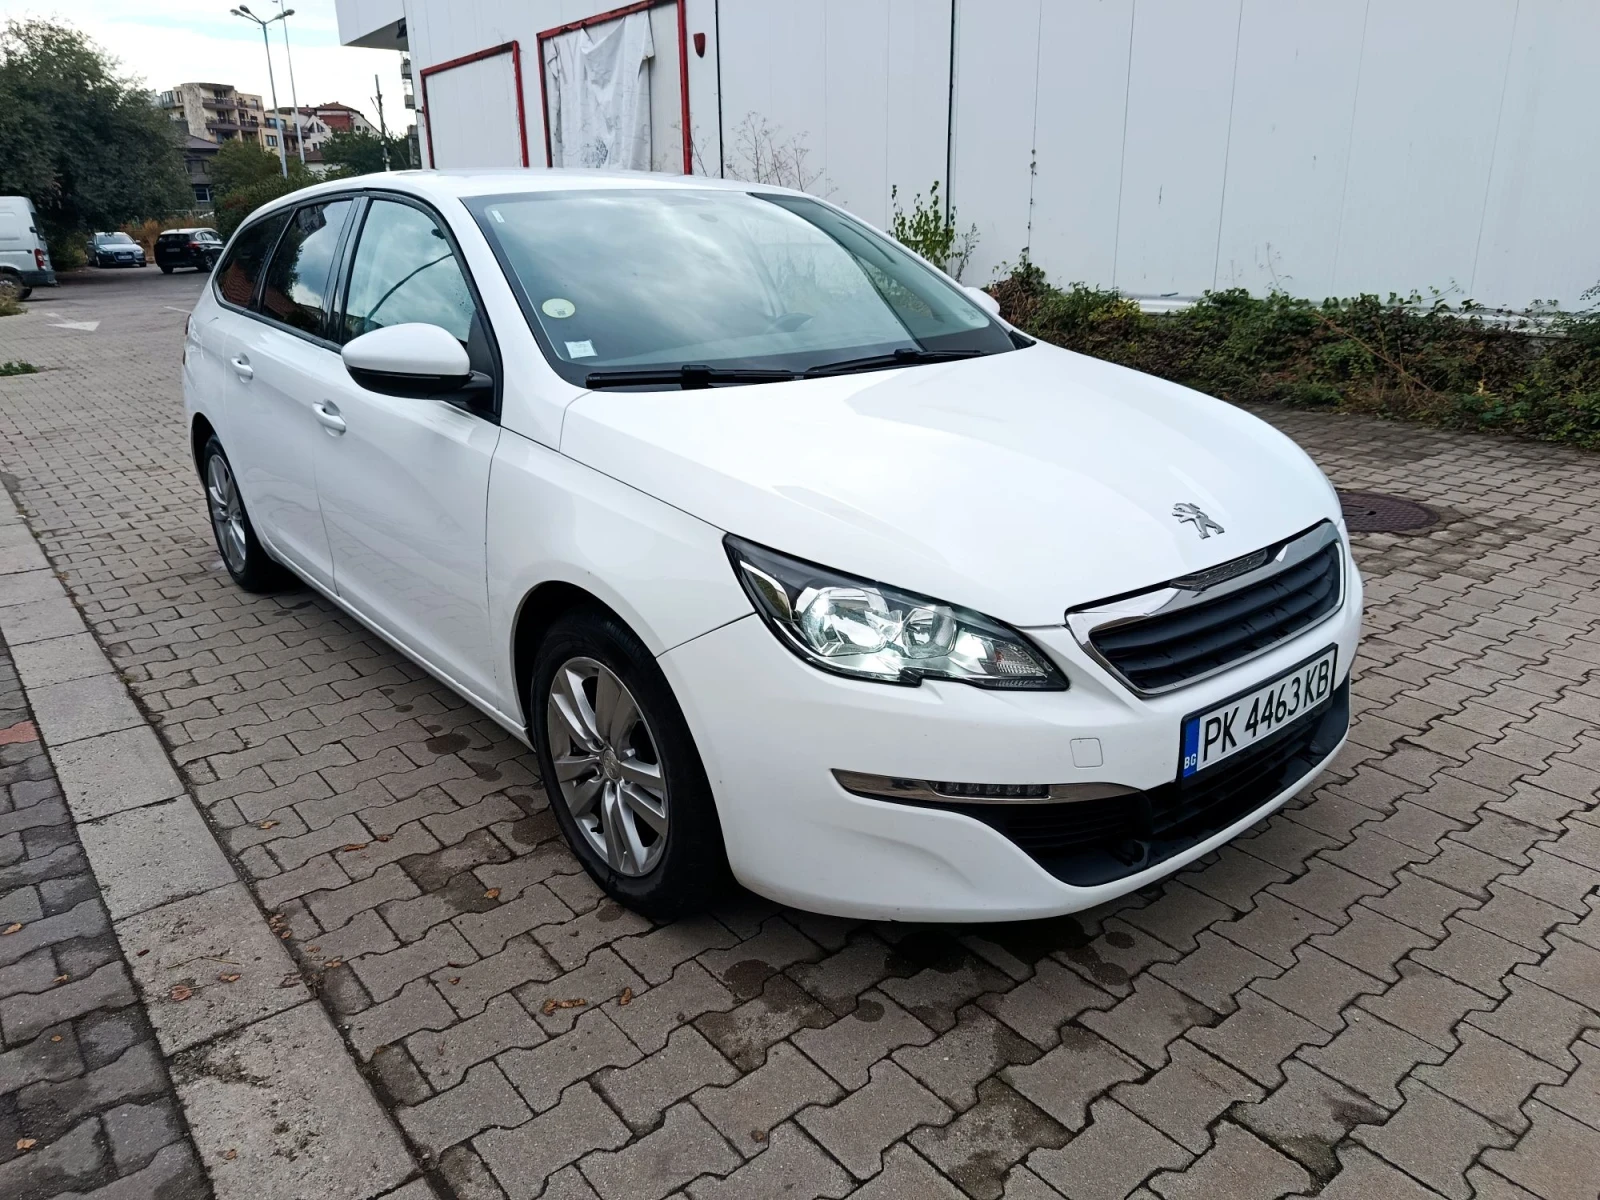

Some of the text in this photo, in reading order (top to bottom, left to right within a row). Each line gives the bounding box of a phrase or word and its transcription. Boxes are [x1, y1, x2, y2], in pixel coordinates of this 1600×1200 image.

[1203, 659, 1330, 762] PK 4463 KB
[1183, 753, 1197, 770] BG
